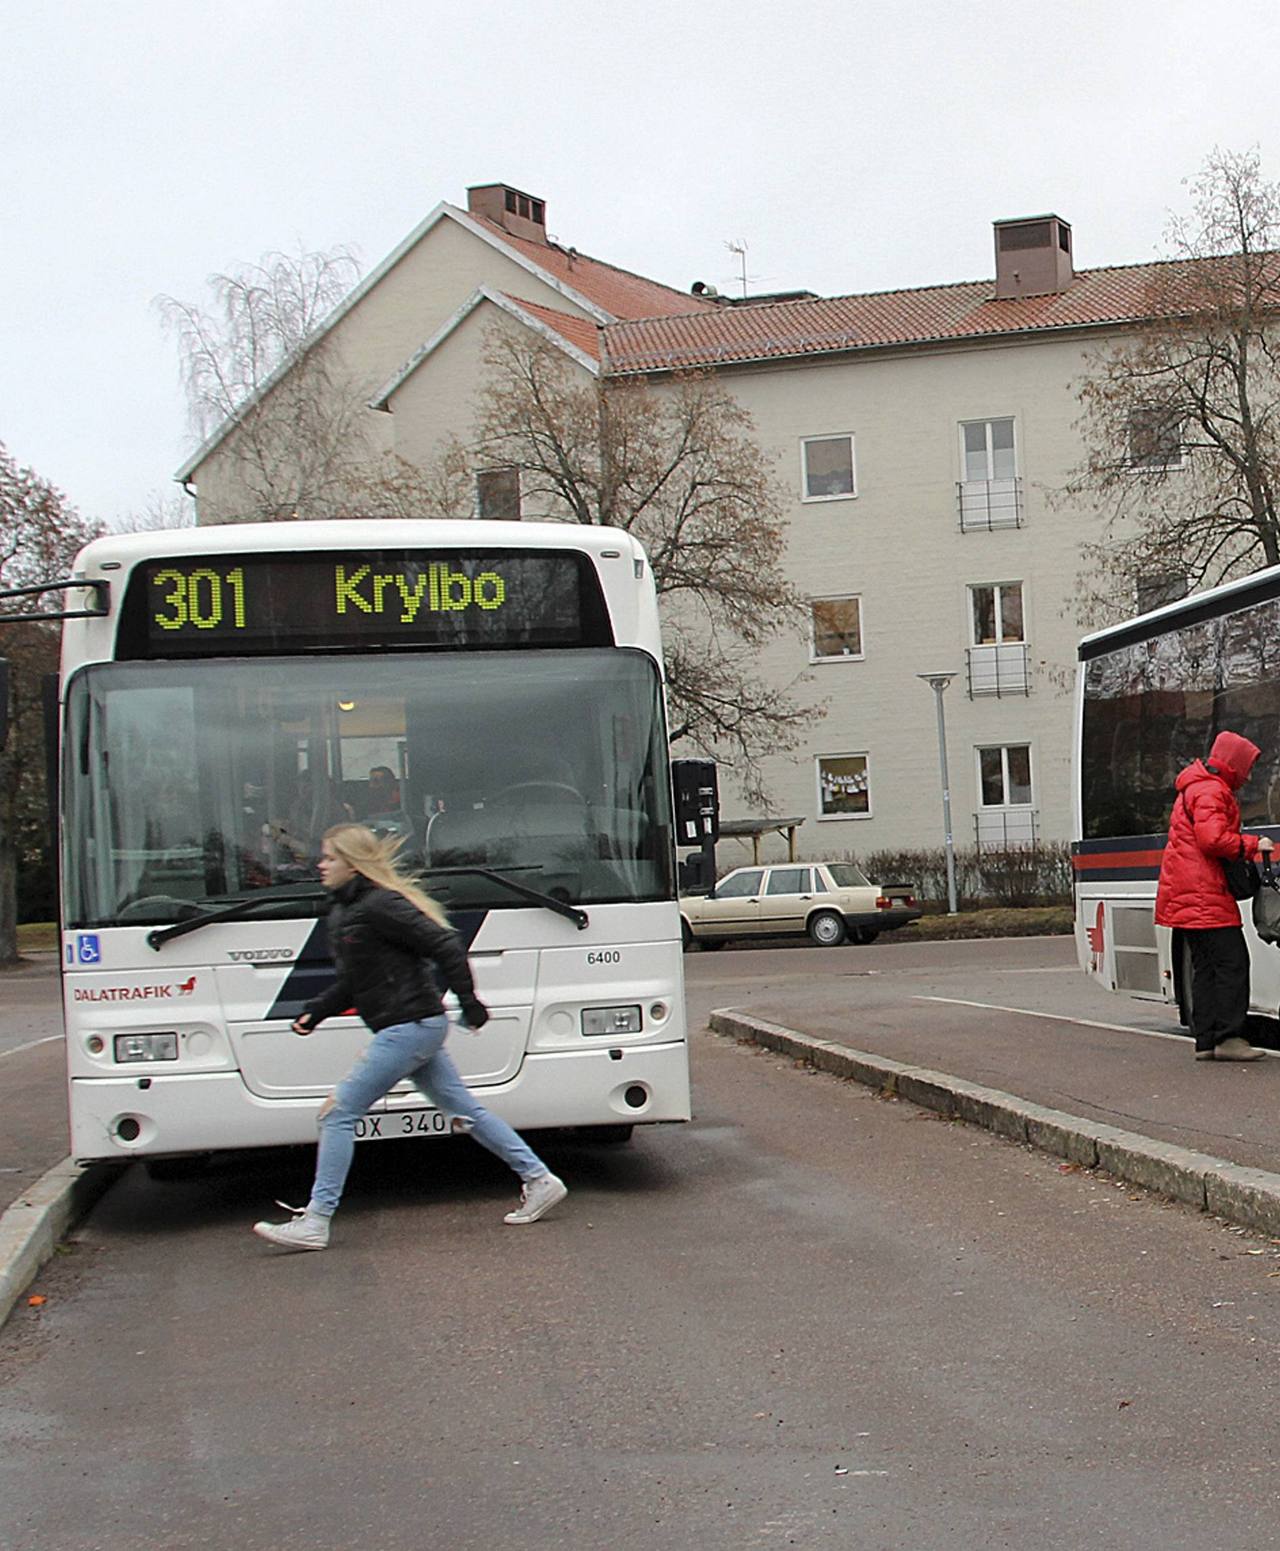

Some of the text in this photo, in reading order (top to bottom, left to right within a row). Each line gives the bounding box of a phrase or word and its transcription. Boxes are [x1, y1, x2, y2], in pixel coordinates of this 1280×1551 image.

[154, 562, 505, 629] 301 Krylbo
[227, 949, 294, 962] VOLVO
[587, 950, 621, 965] 6400
[74, 984, 172, 1001] DALATRAFIK
[354, 1113, 446, 1138] OX 340
